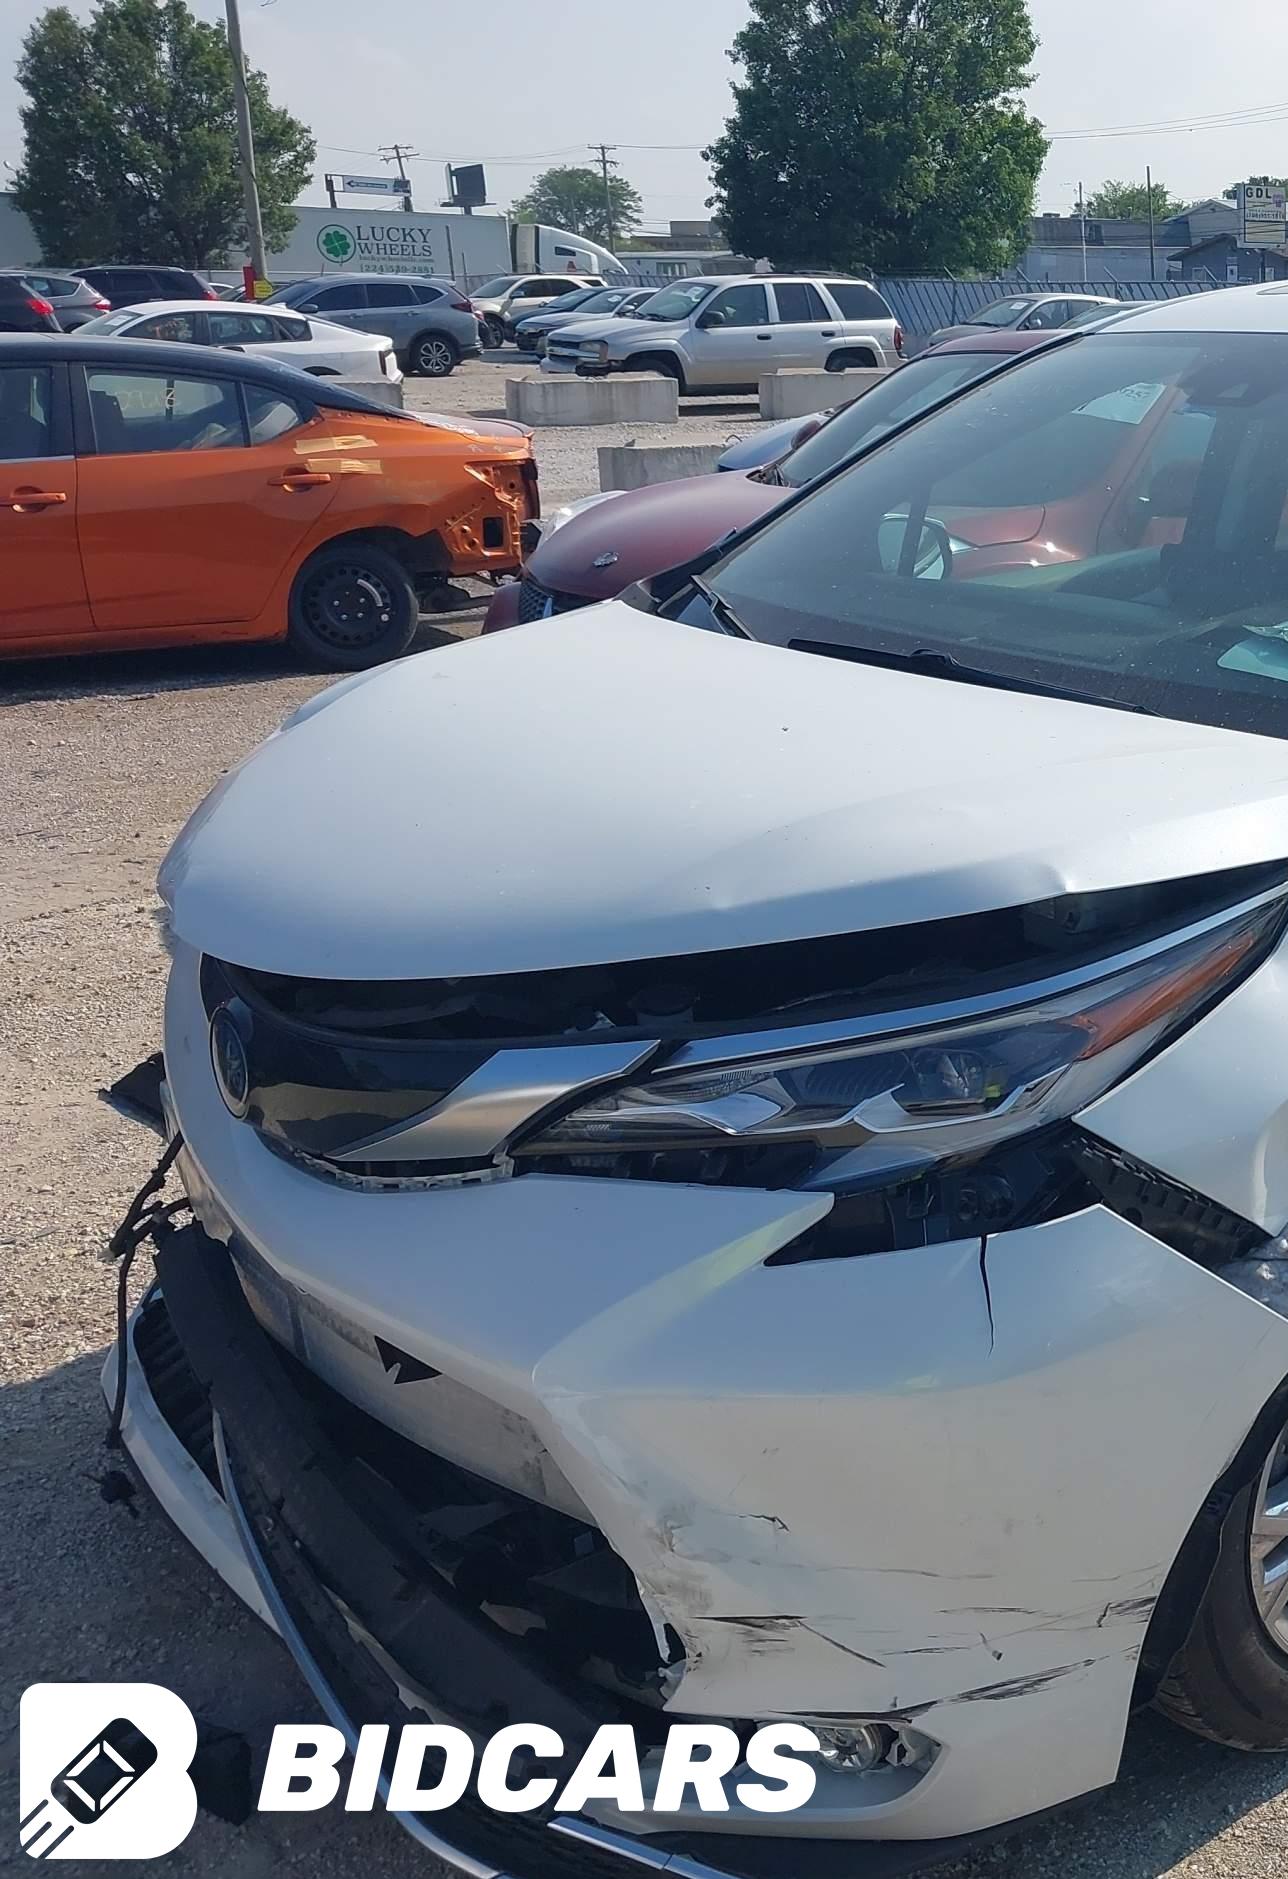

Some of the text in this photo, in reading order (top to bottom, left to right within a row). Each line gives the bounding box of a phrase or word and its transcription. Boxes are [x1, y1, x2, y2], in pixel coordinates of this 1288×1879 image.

[1246, 187, 1272, 199] GDL
[356, 225, 432, 243] LUCKY
[357, 242, 433, 257] WHEELS
